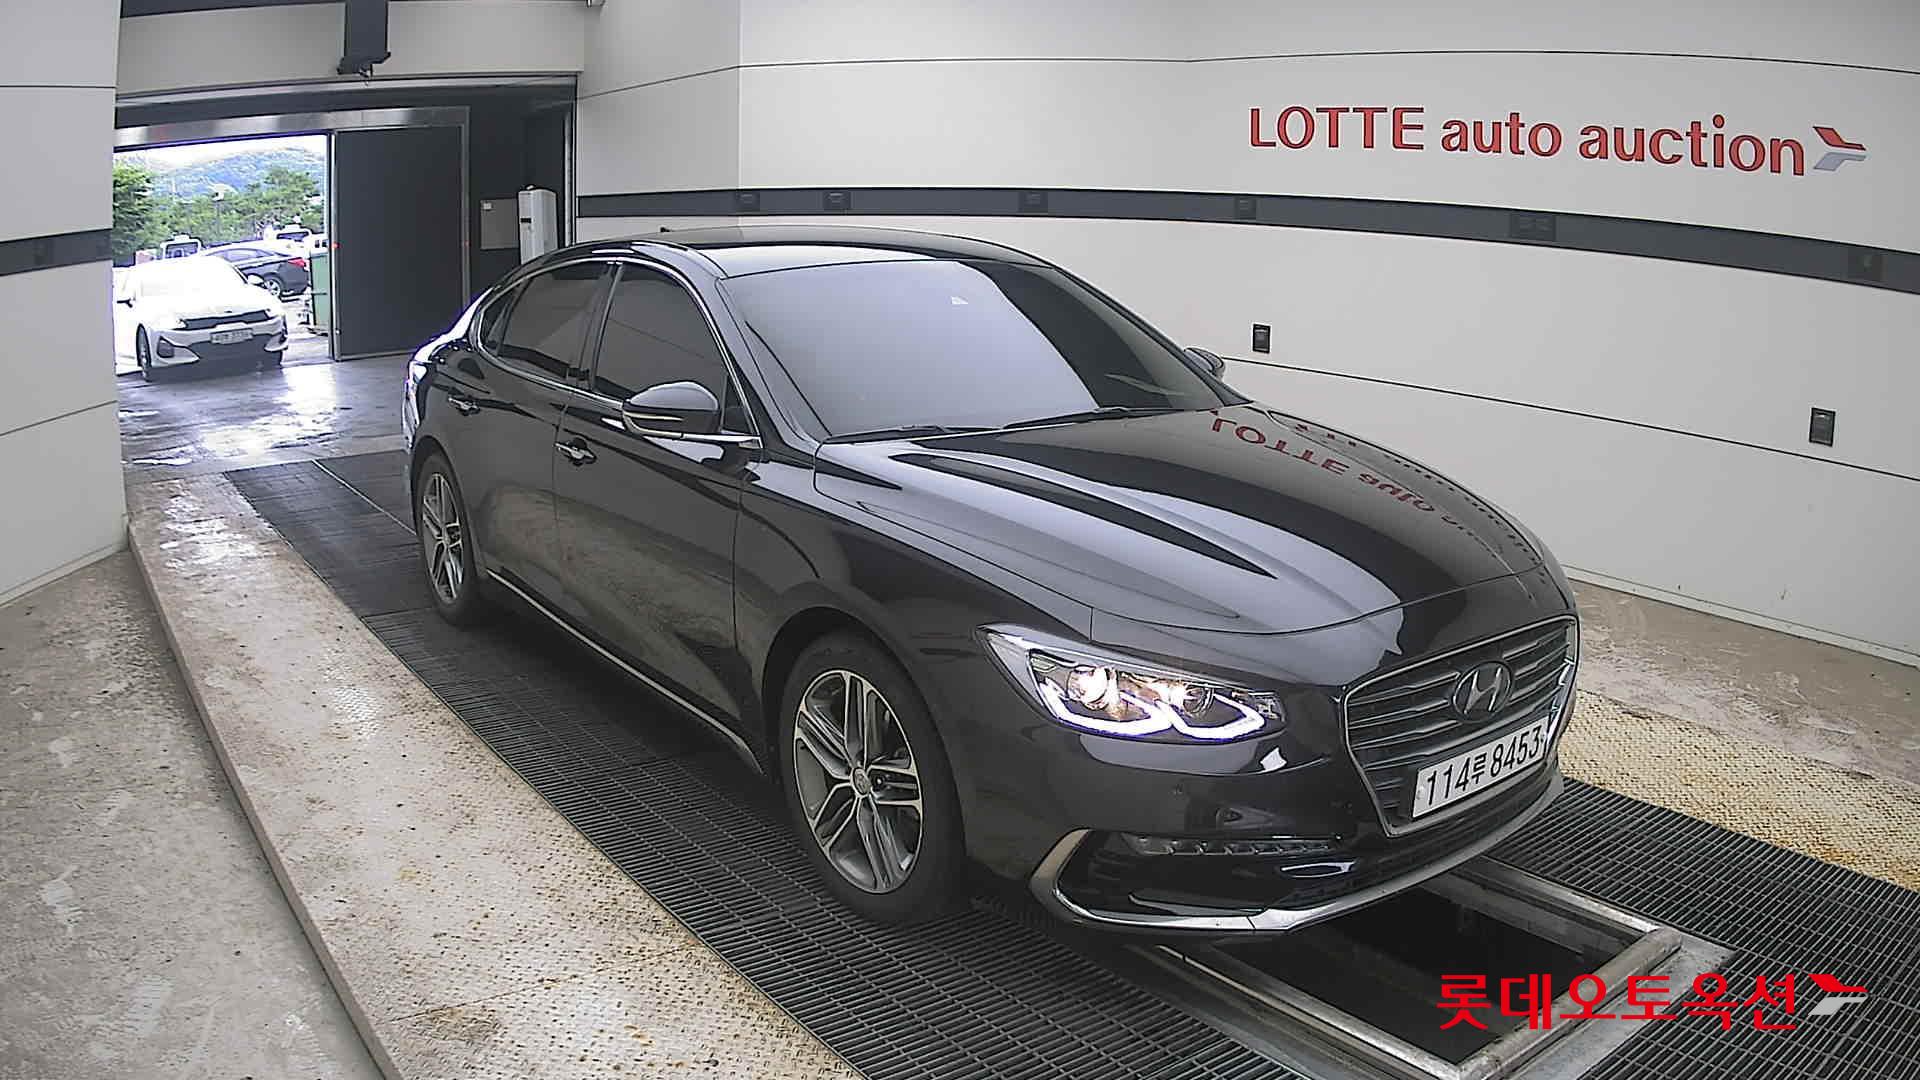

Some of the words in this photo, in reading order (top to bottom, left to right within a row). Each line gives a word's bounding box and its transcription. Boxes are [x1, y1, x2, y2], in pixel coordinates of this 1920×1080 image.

[1249, 106, 1424, 150] LOTTE
[1441, 111, 1562, 157] auto
[1579, 114, 1805, 176] auction
